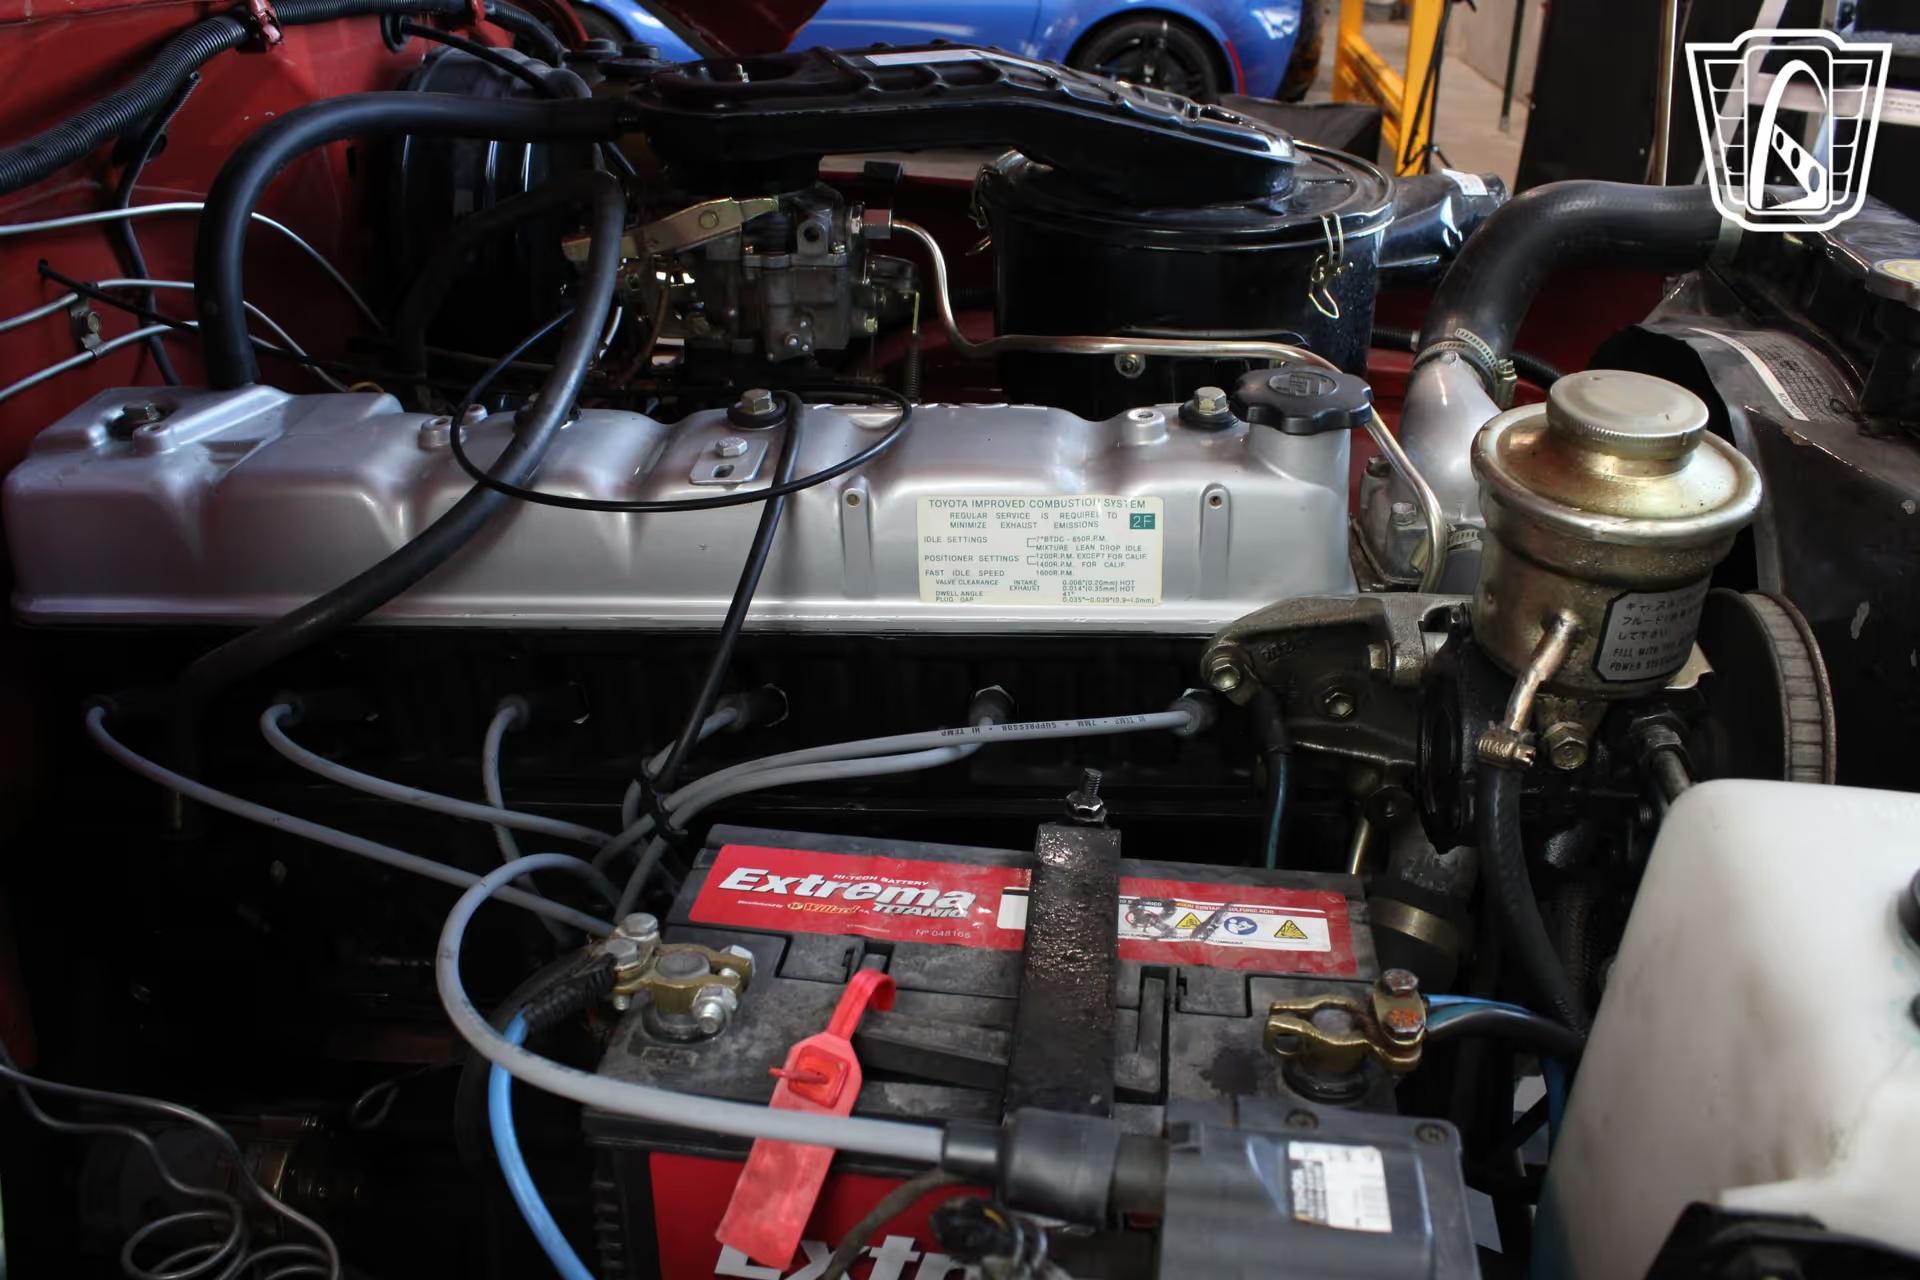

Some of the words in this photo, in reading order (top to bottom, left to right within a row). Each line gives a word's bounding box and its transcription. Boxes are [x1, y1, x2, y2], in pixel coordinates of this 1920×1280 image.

[928, 499, 968, 508] TOYOTA
[972, 499, 1025, 508] IMPROVED
[1107, 511, 1118, 519] TO
[950, 521, 987, 529] MINIMIZE
[1000, 521, 1038, 529] EXHAUST
[1054, 520, 1099, 529] EMISSIONS
[1132, 515, 1153, 528] 2F
[1002, 722, 1057, 732] SUPPRESSOR
[879, 877, 930, 887] BATTERY
[718, 867, 976, 911] Extrema
